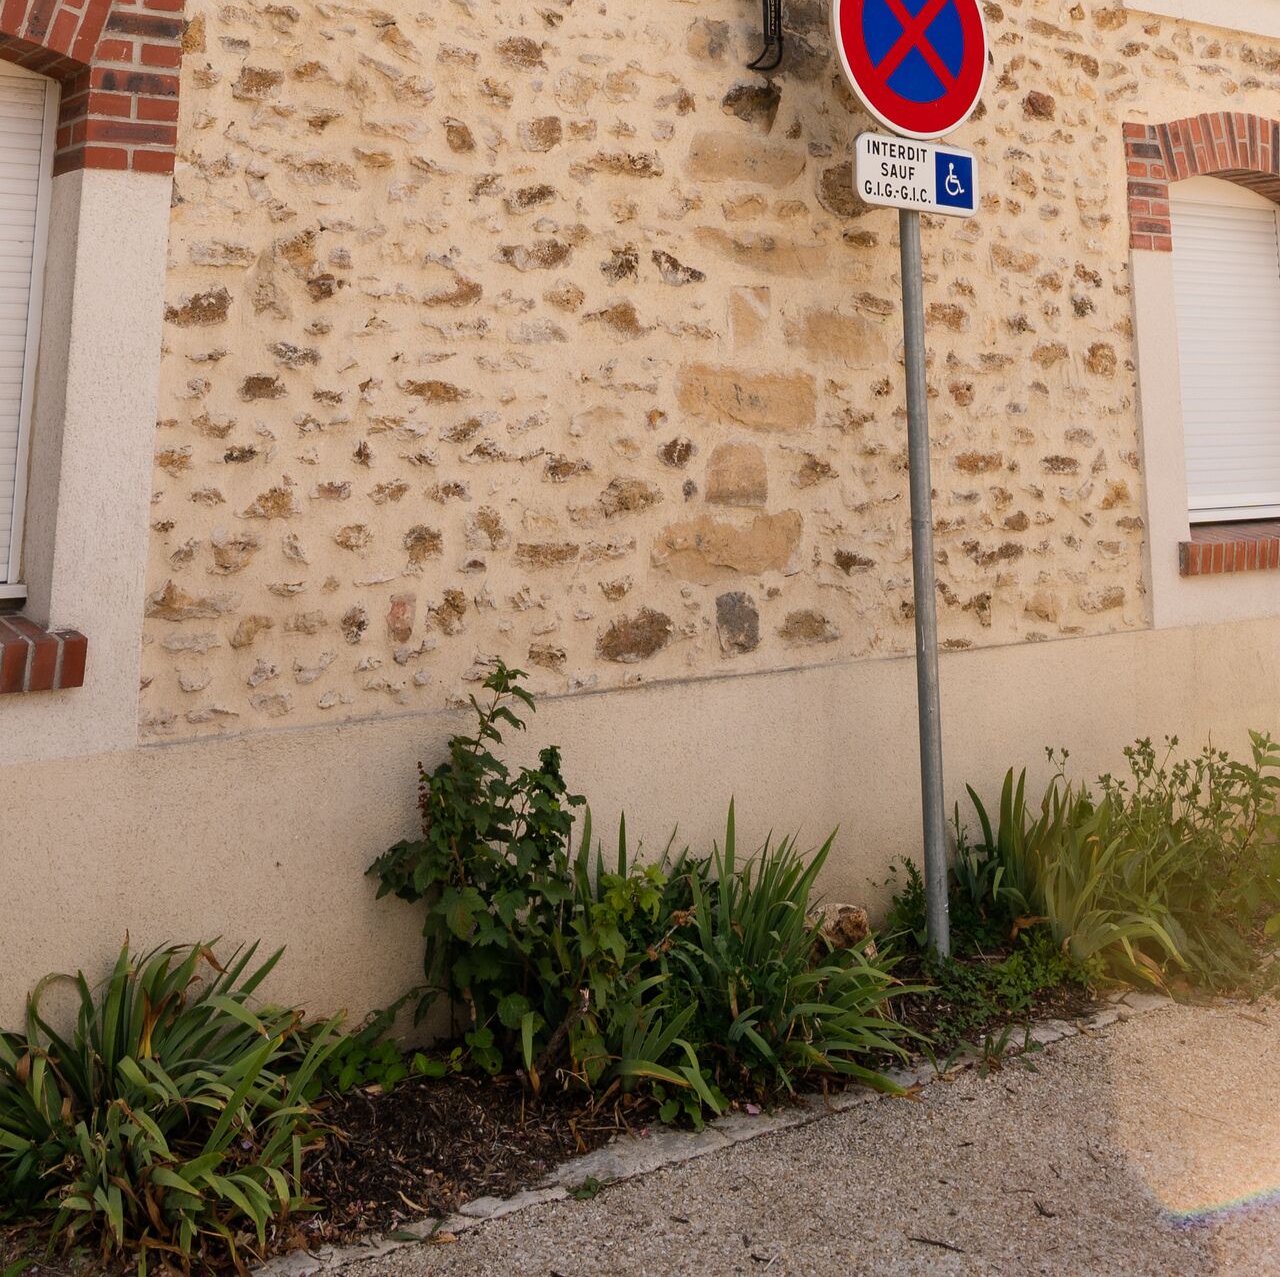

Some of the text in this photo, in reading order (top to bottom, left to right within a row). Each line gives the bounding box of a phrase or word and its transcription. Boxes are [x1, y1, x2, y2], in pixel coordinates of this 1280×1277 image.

[867, 139, 927, 163] INTERDIT
[881, 162, 915, 181] SAUF
[864, 180, 931, 203] G.I.G.-G.I.C.
